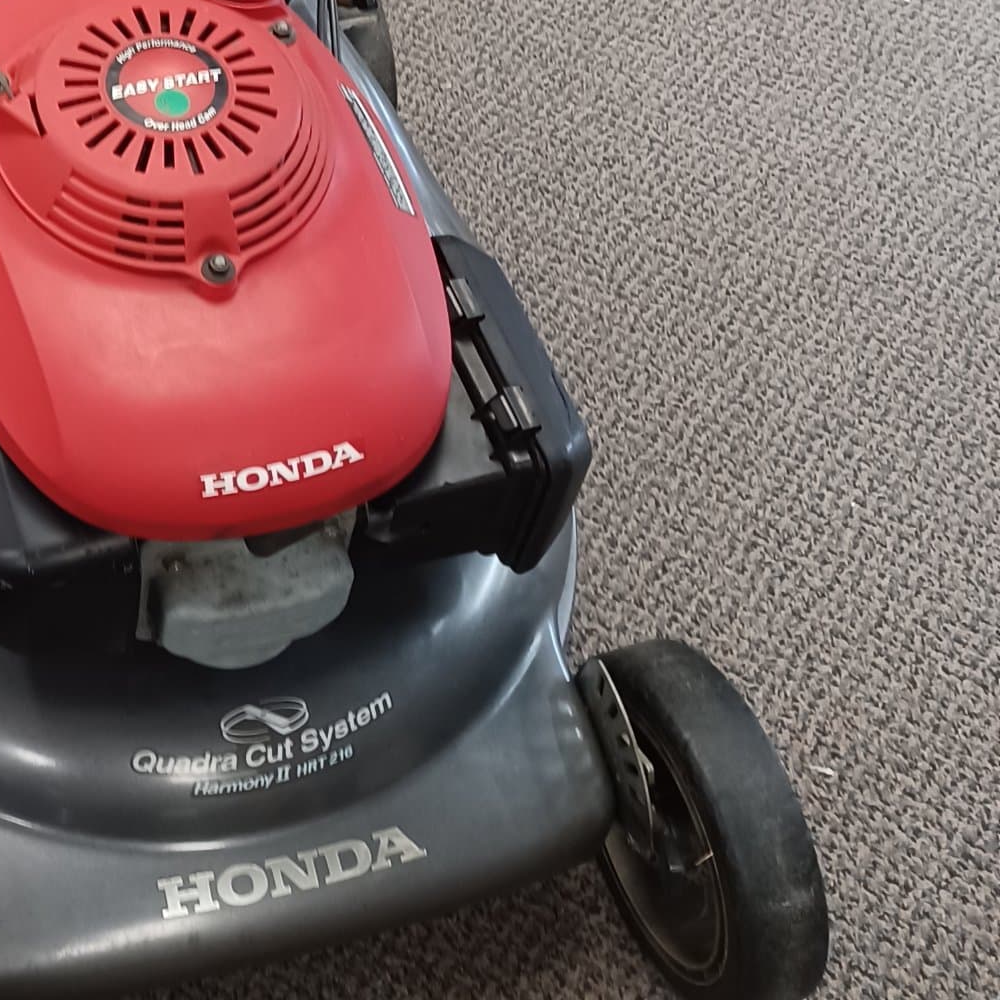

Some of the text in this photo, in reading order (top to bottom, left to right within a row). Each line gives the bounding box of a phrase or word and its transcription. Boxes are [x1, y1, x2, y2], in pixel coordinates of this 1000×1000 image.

[111, 68, 222, 100] EASY START
[200, 441, 364, 498] HONDA
[132, 691, 393, 774] Quadra Cut System
[193, 773, 274, 796] Harmony
[157, 826, 428, 919] HONDA
